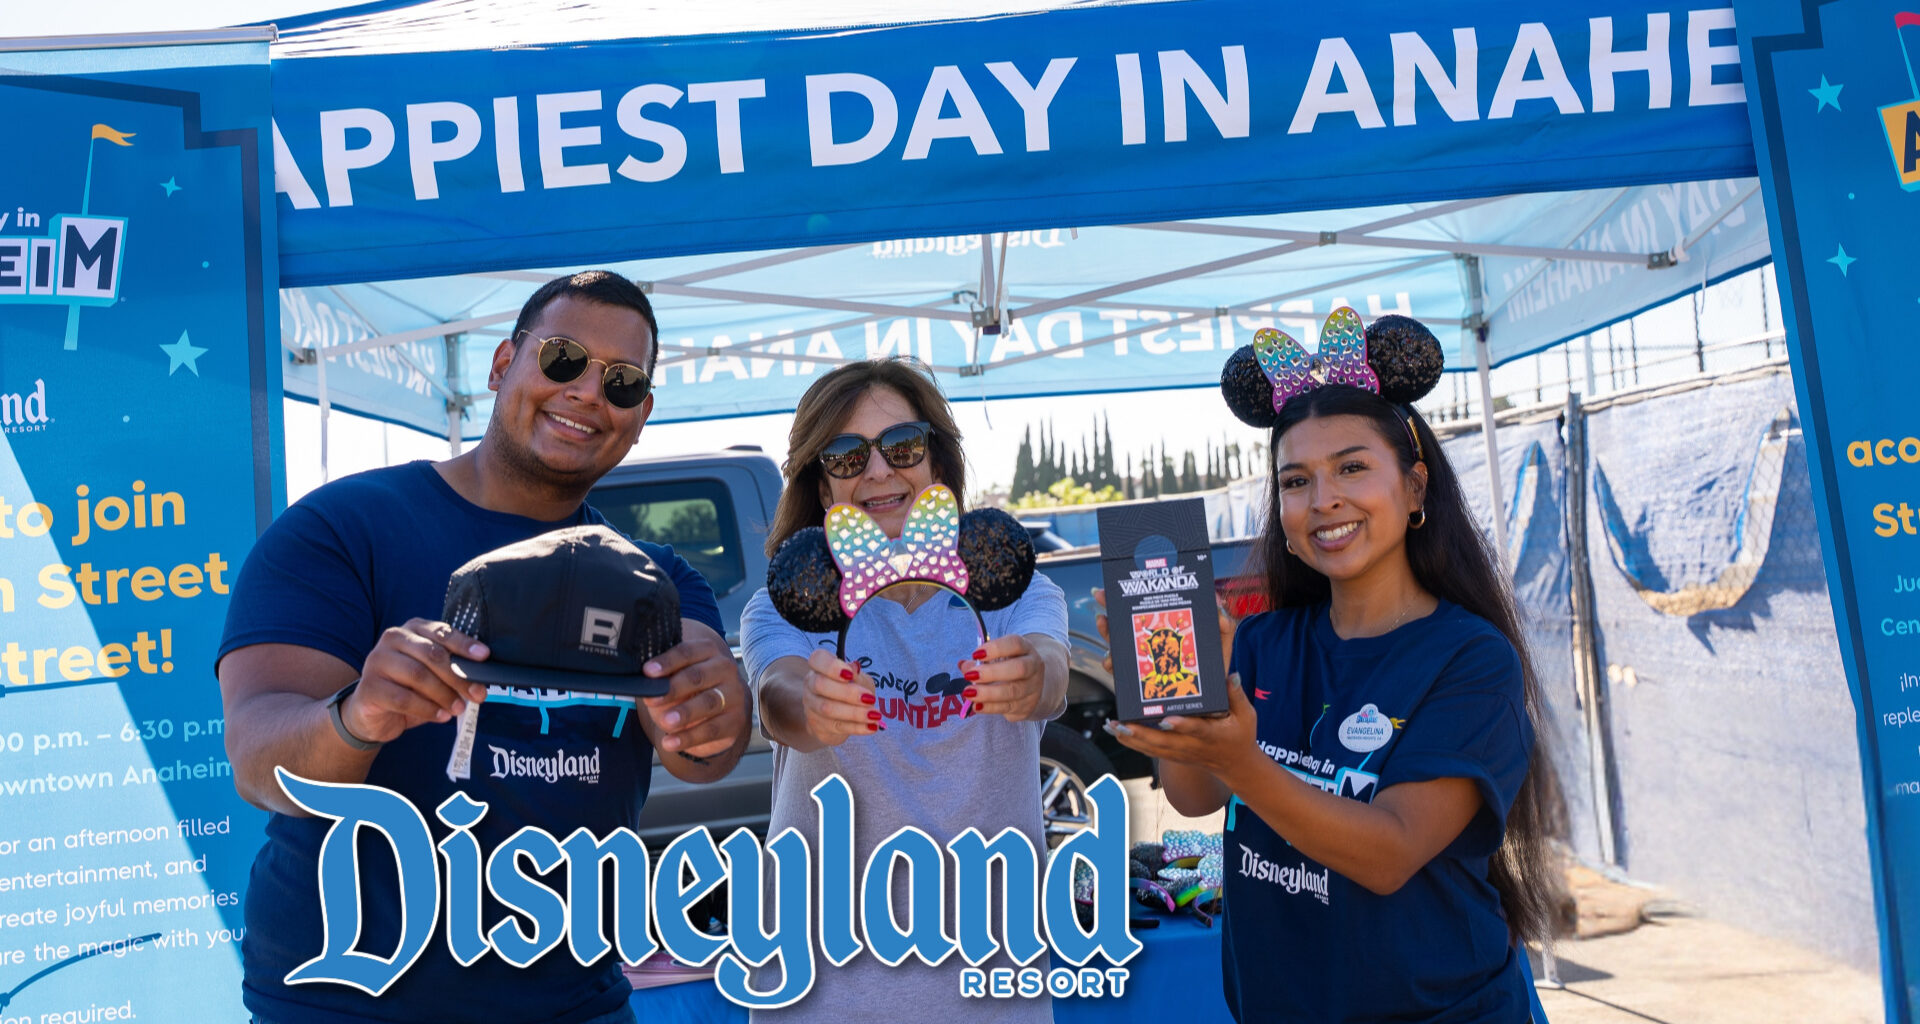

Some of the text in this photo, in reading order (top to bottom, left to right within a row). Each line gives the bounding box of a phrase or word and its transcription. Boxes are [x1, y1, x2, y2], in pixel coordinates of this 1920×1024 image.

[805, 57, 1078, 167] DAY
[1116, 46, 1250, 145] IN
[1288, 8, 1748, 135] ANAHE
[17, 207, 40, 227] in
[5, 425, 47, 433] RESORT
[0, 480, 185, 546] to join
[1873, 502, 1920, 538] St
[37, 553, 229, 609] Street
[1118, 574, 1199, 594] WAKANDA
[1129, 566, 1170, 579] WORLD
[0, 629, 174, 685] treet!
[33, 731, 89, 756] p.m.
[120, 721, 174, 744] 6:30
[1346, 726, 1384, 735] EVANGELINA
[123, 757, 233, 786] Anaheim
[488, 744, 600, 783] Disneyland
[1321, 758, 1335, 775] in
[28, 837, 56, 852] an
[64, 825, 168, 849] afternoon
[177, 816, 230, 838] filled
[0, 854, 207, 892] entertainment, and
[1239, 843, 1329, 896] Disneyland
[64, 898, 126, 926] joyful
[133, 889, 239, 915] memories
[34, 942, 70, 961] the
[78, 934, 144, 958] magic
[152, 928, 198, 949] with
[206, 926, 247, 949] you
[41, 1000, 136, 1024] required.
